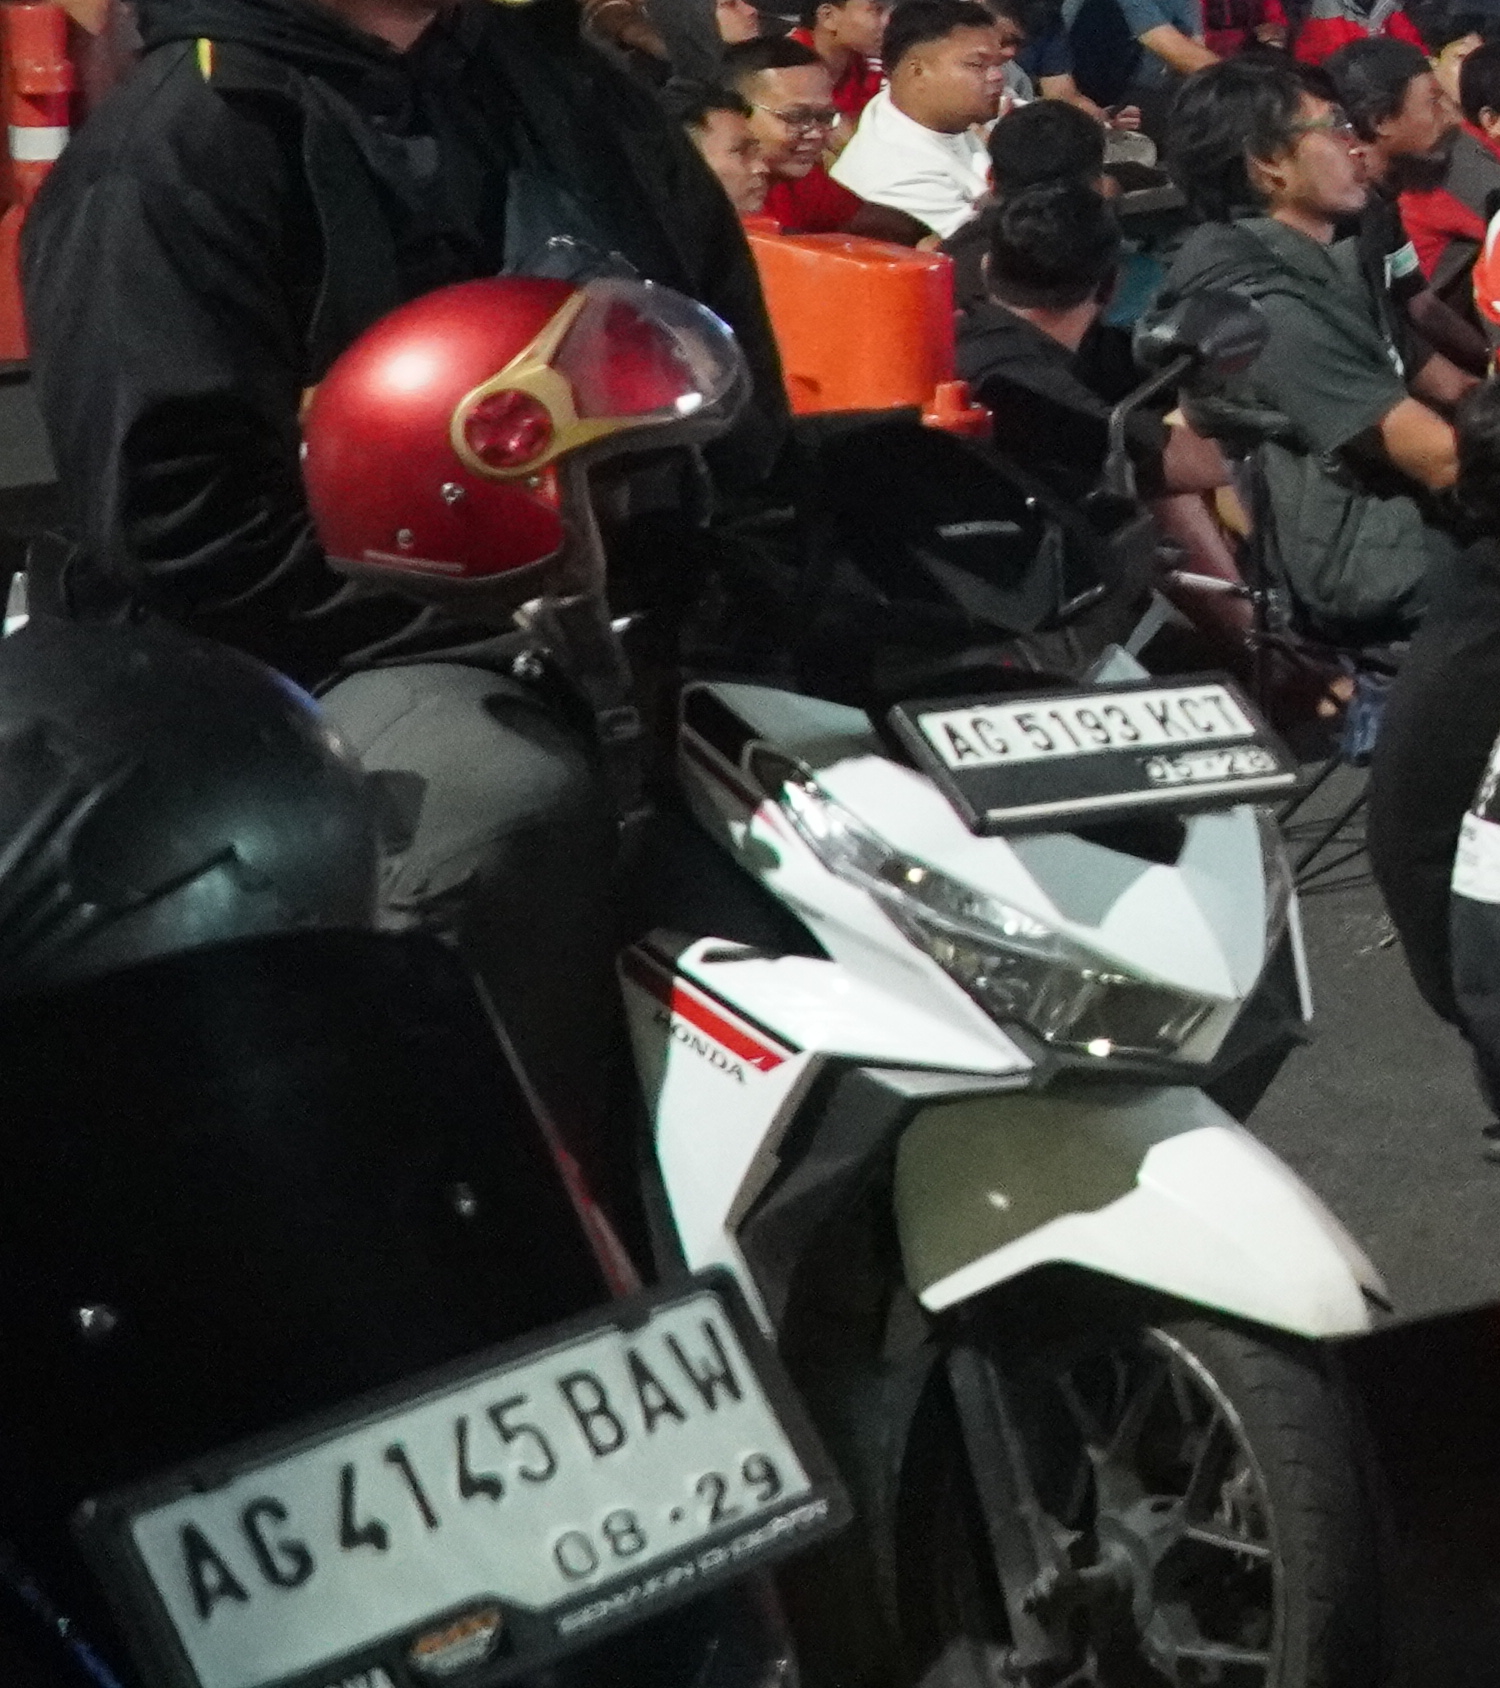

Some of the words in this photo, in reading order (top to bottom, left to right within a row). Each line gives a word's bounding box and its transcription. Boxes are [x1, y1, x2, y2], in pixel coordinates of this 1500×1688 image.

[942, 717, 1009, 762] AG
[1014, 703, 1140, 753] 5193
[176, 1492, 317, 1622] AG
[338, 1391, 558, 1553] 4145
[554, 1315, 746, 1460] BAW
